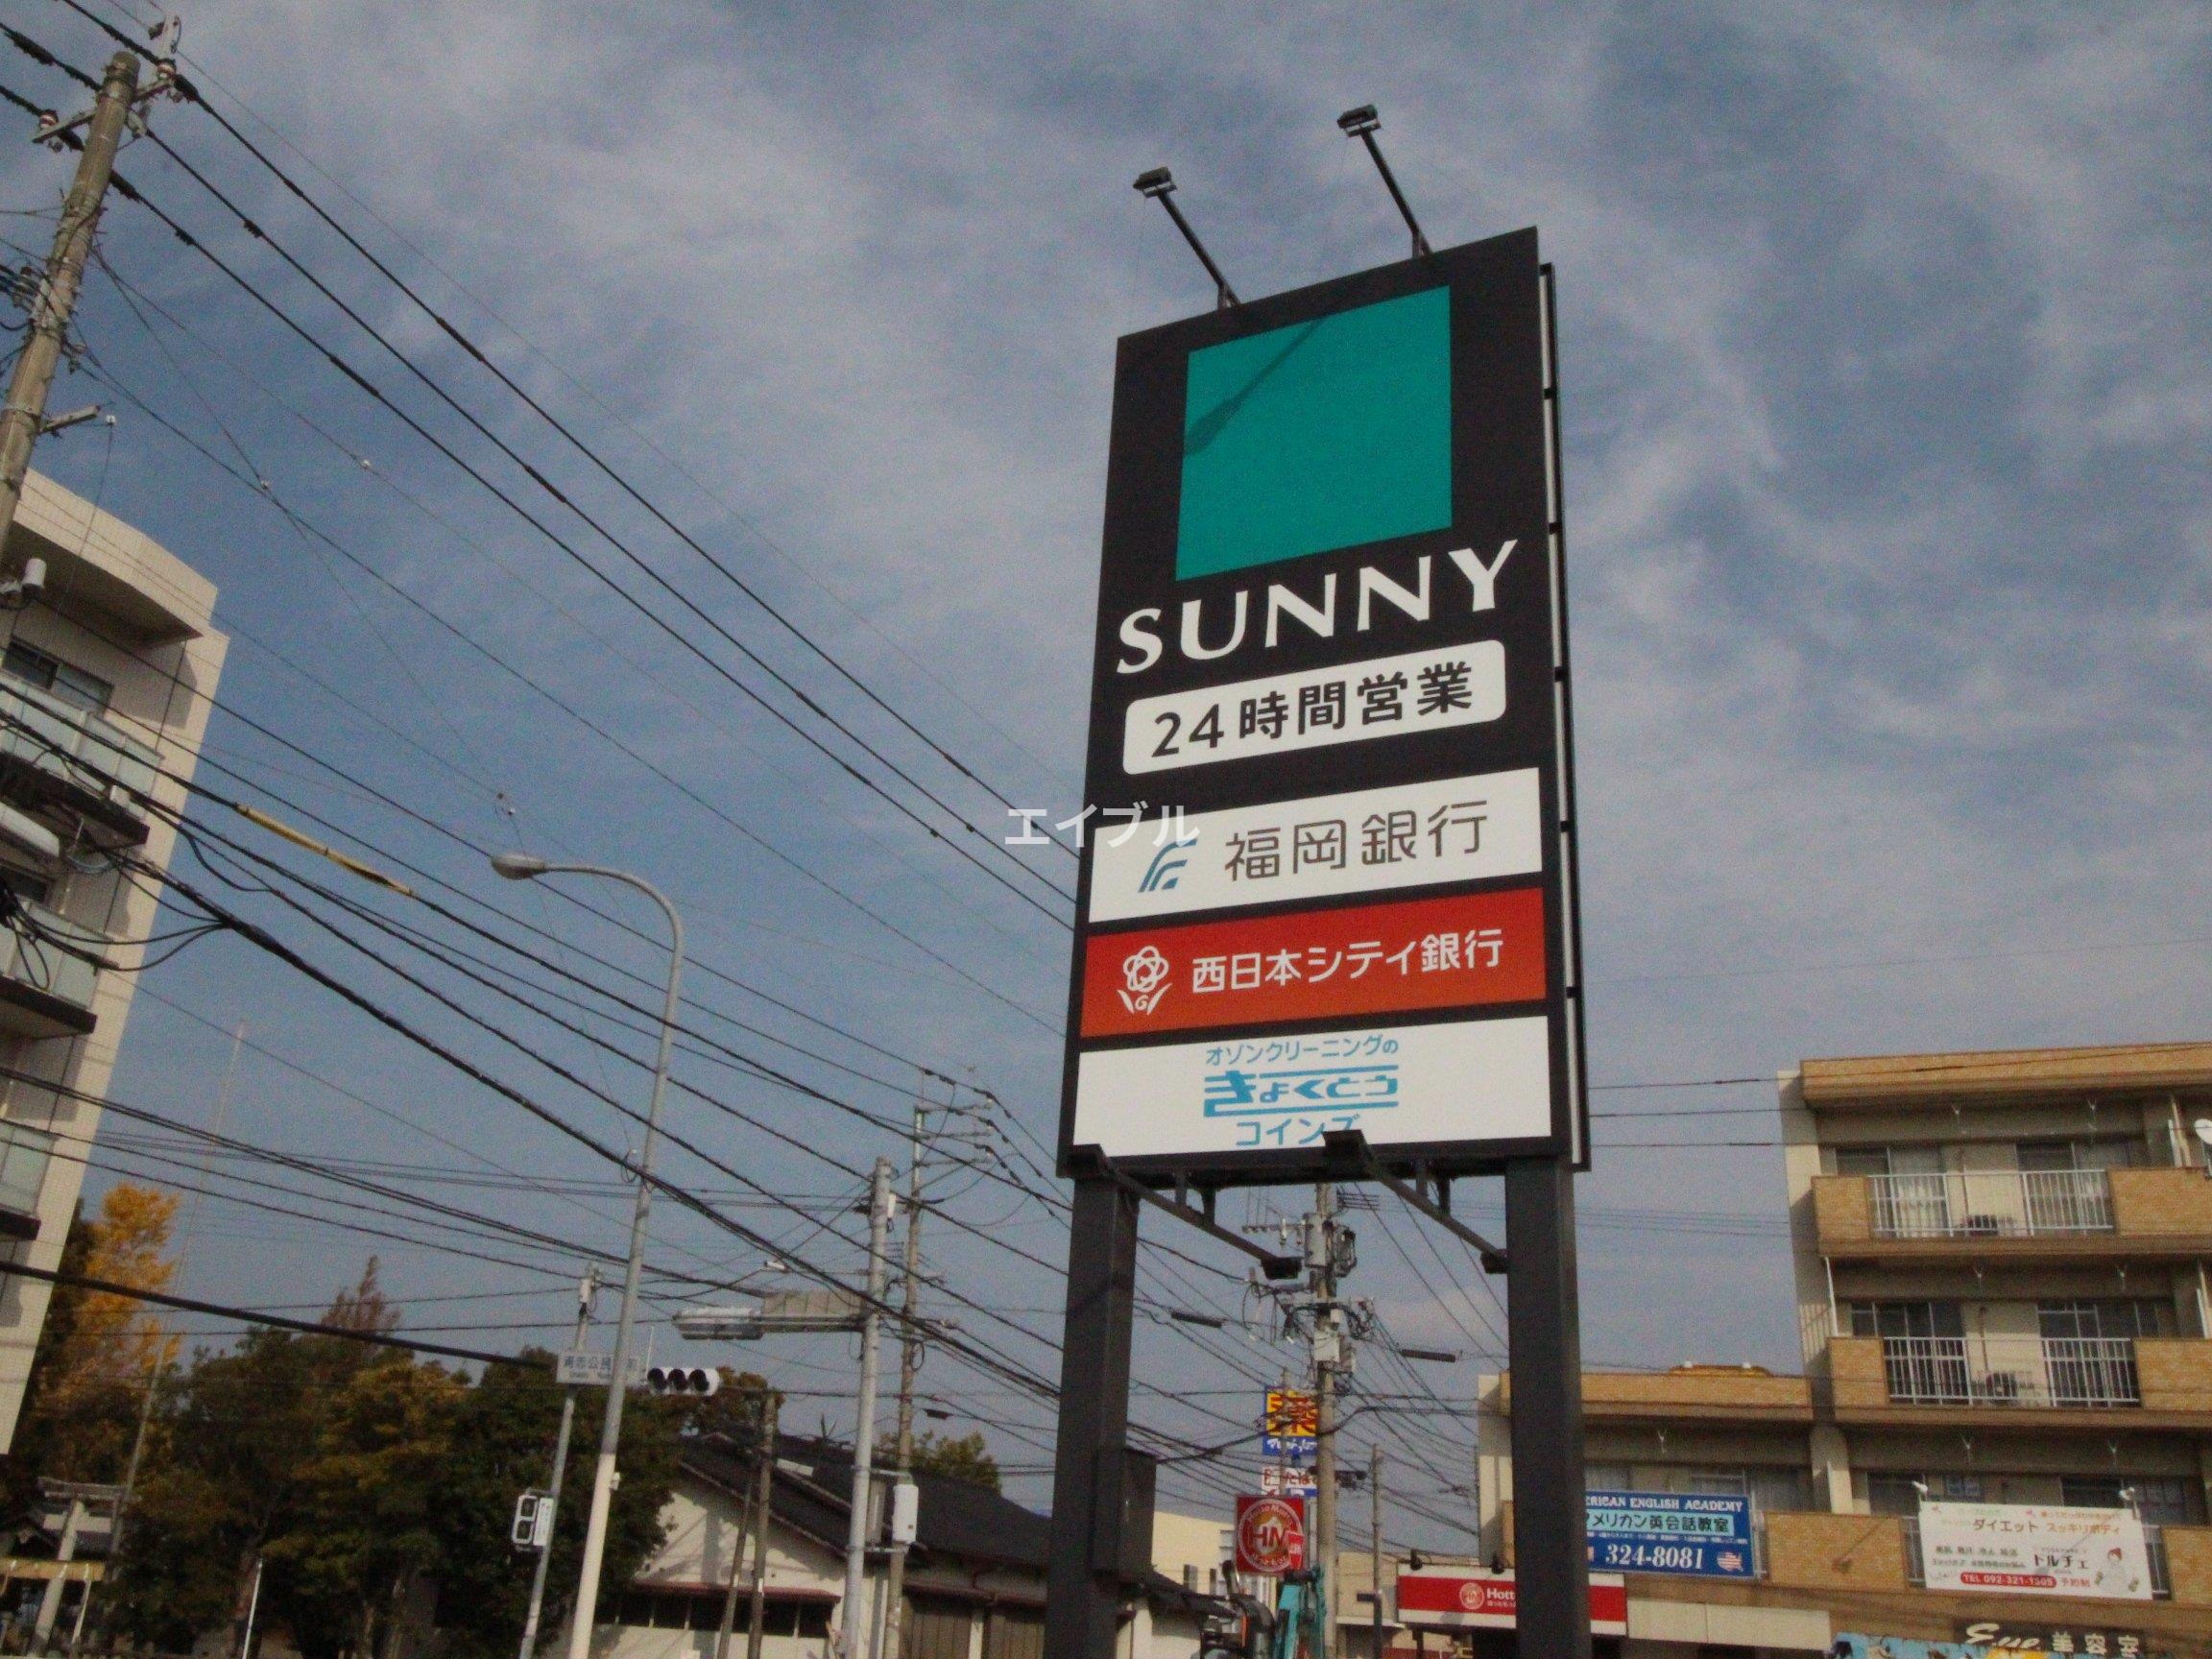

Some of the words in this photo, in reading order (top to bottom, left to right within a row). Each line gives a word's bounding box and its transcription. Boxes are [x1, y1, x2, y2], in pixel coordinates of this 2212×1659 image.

[1117, 540, 1518, 674] SUNNY
[1151, 661, 1473, 758] 24時間営業
[1224, 800, 1488, 882] 福岡銀行
[1206, 1034, 1399, 1066] オゾンクリーニングの
[1204, 1068, 1399, 1118] きょくとう
[1630, 1498, 1679, 1509] ENGLISH
[1685, 1500, 1743, 1512] ACADEMY
[1973, 1519, 2038, 1533] ダイエット
[1605, 1544, 1703, 1569] 324-8081
